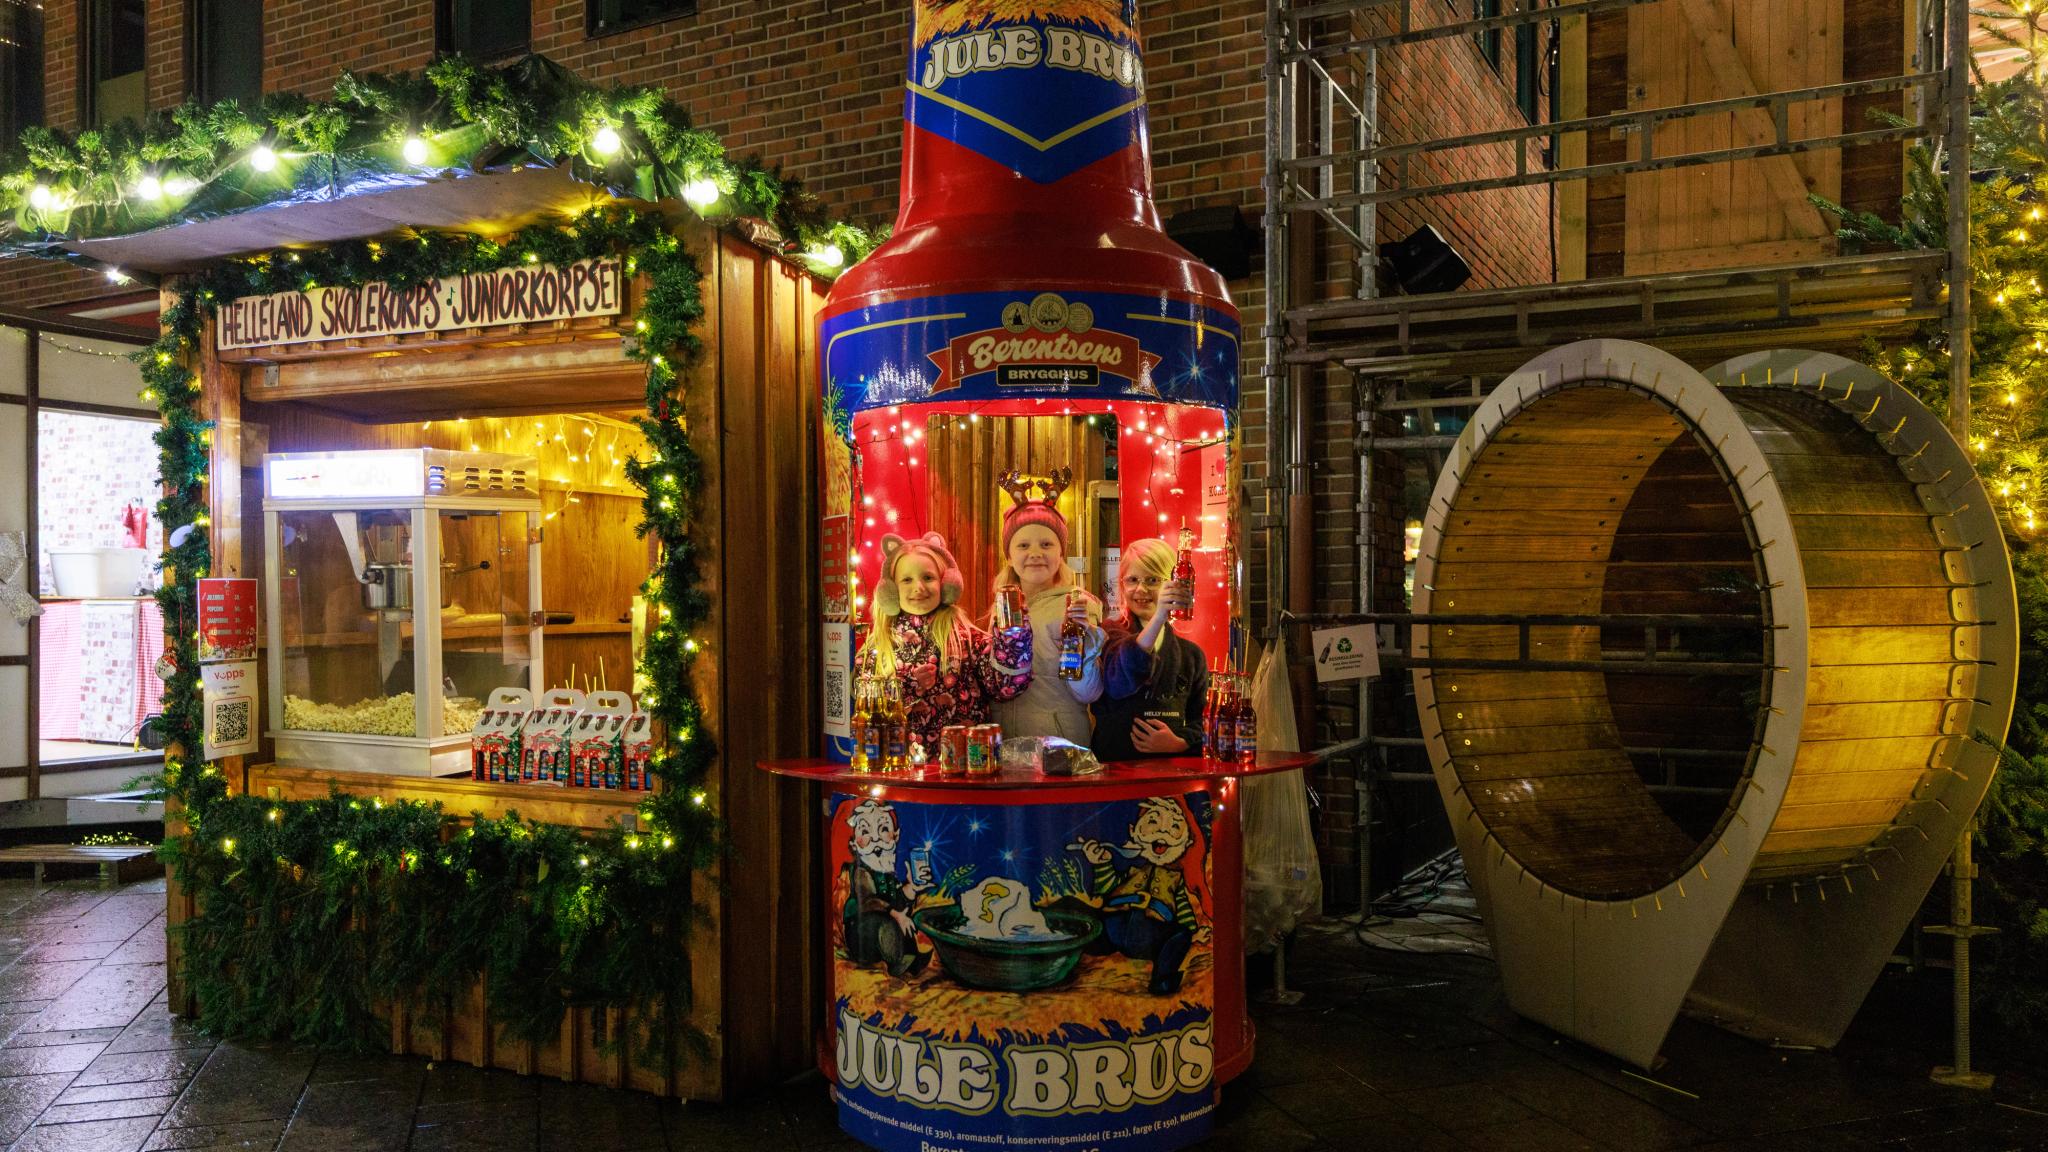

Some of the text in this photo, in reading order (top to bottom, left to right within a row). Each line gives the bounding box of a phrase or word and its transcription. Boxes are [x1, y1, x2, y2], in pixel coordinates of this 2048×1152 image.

[922, 26, 1041, 90] JULE
[222, 260, 620, 346] HELLELAND SKOLEKORPS JUNIORKORPSET
[968, 333, 1122, 369] Berentsens
[1008, 369, 1089, 380] BRYGGHUS
[837, 1010, 1213, 1114] JULE BRUS
[900, 1120, 924, 1134] middel
[926, 1125, 934, 1136] (E
[935, 1129, 955, 1140] 330),
[957, 1133, 1005, 1145] aromastoff,
[1007, 1131, 1100, 1146] konserveringsmiddel
[1102, 1130, 1110, 1141] (E
[1132, 1124, 1152, 1136] farge
[1154, 1120, 1162, 1132] (E
